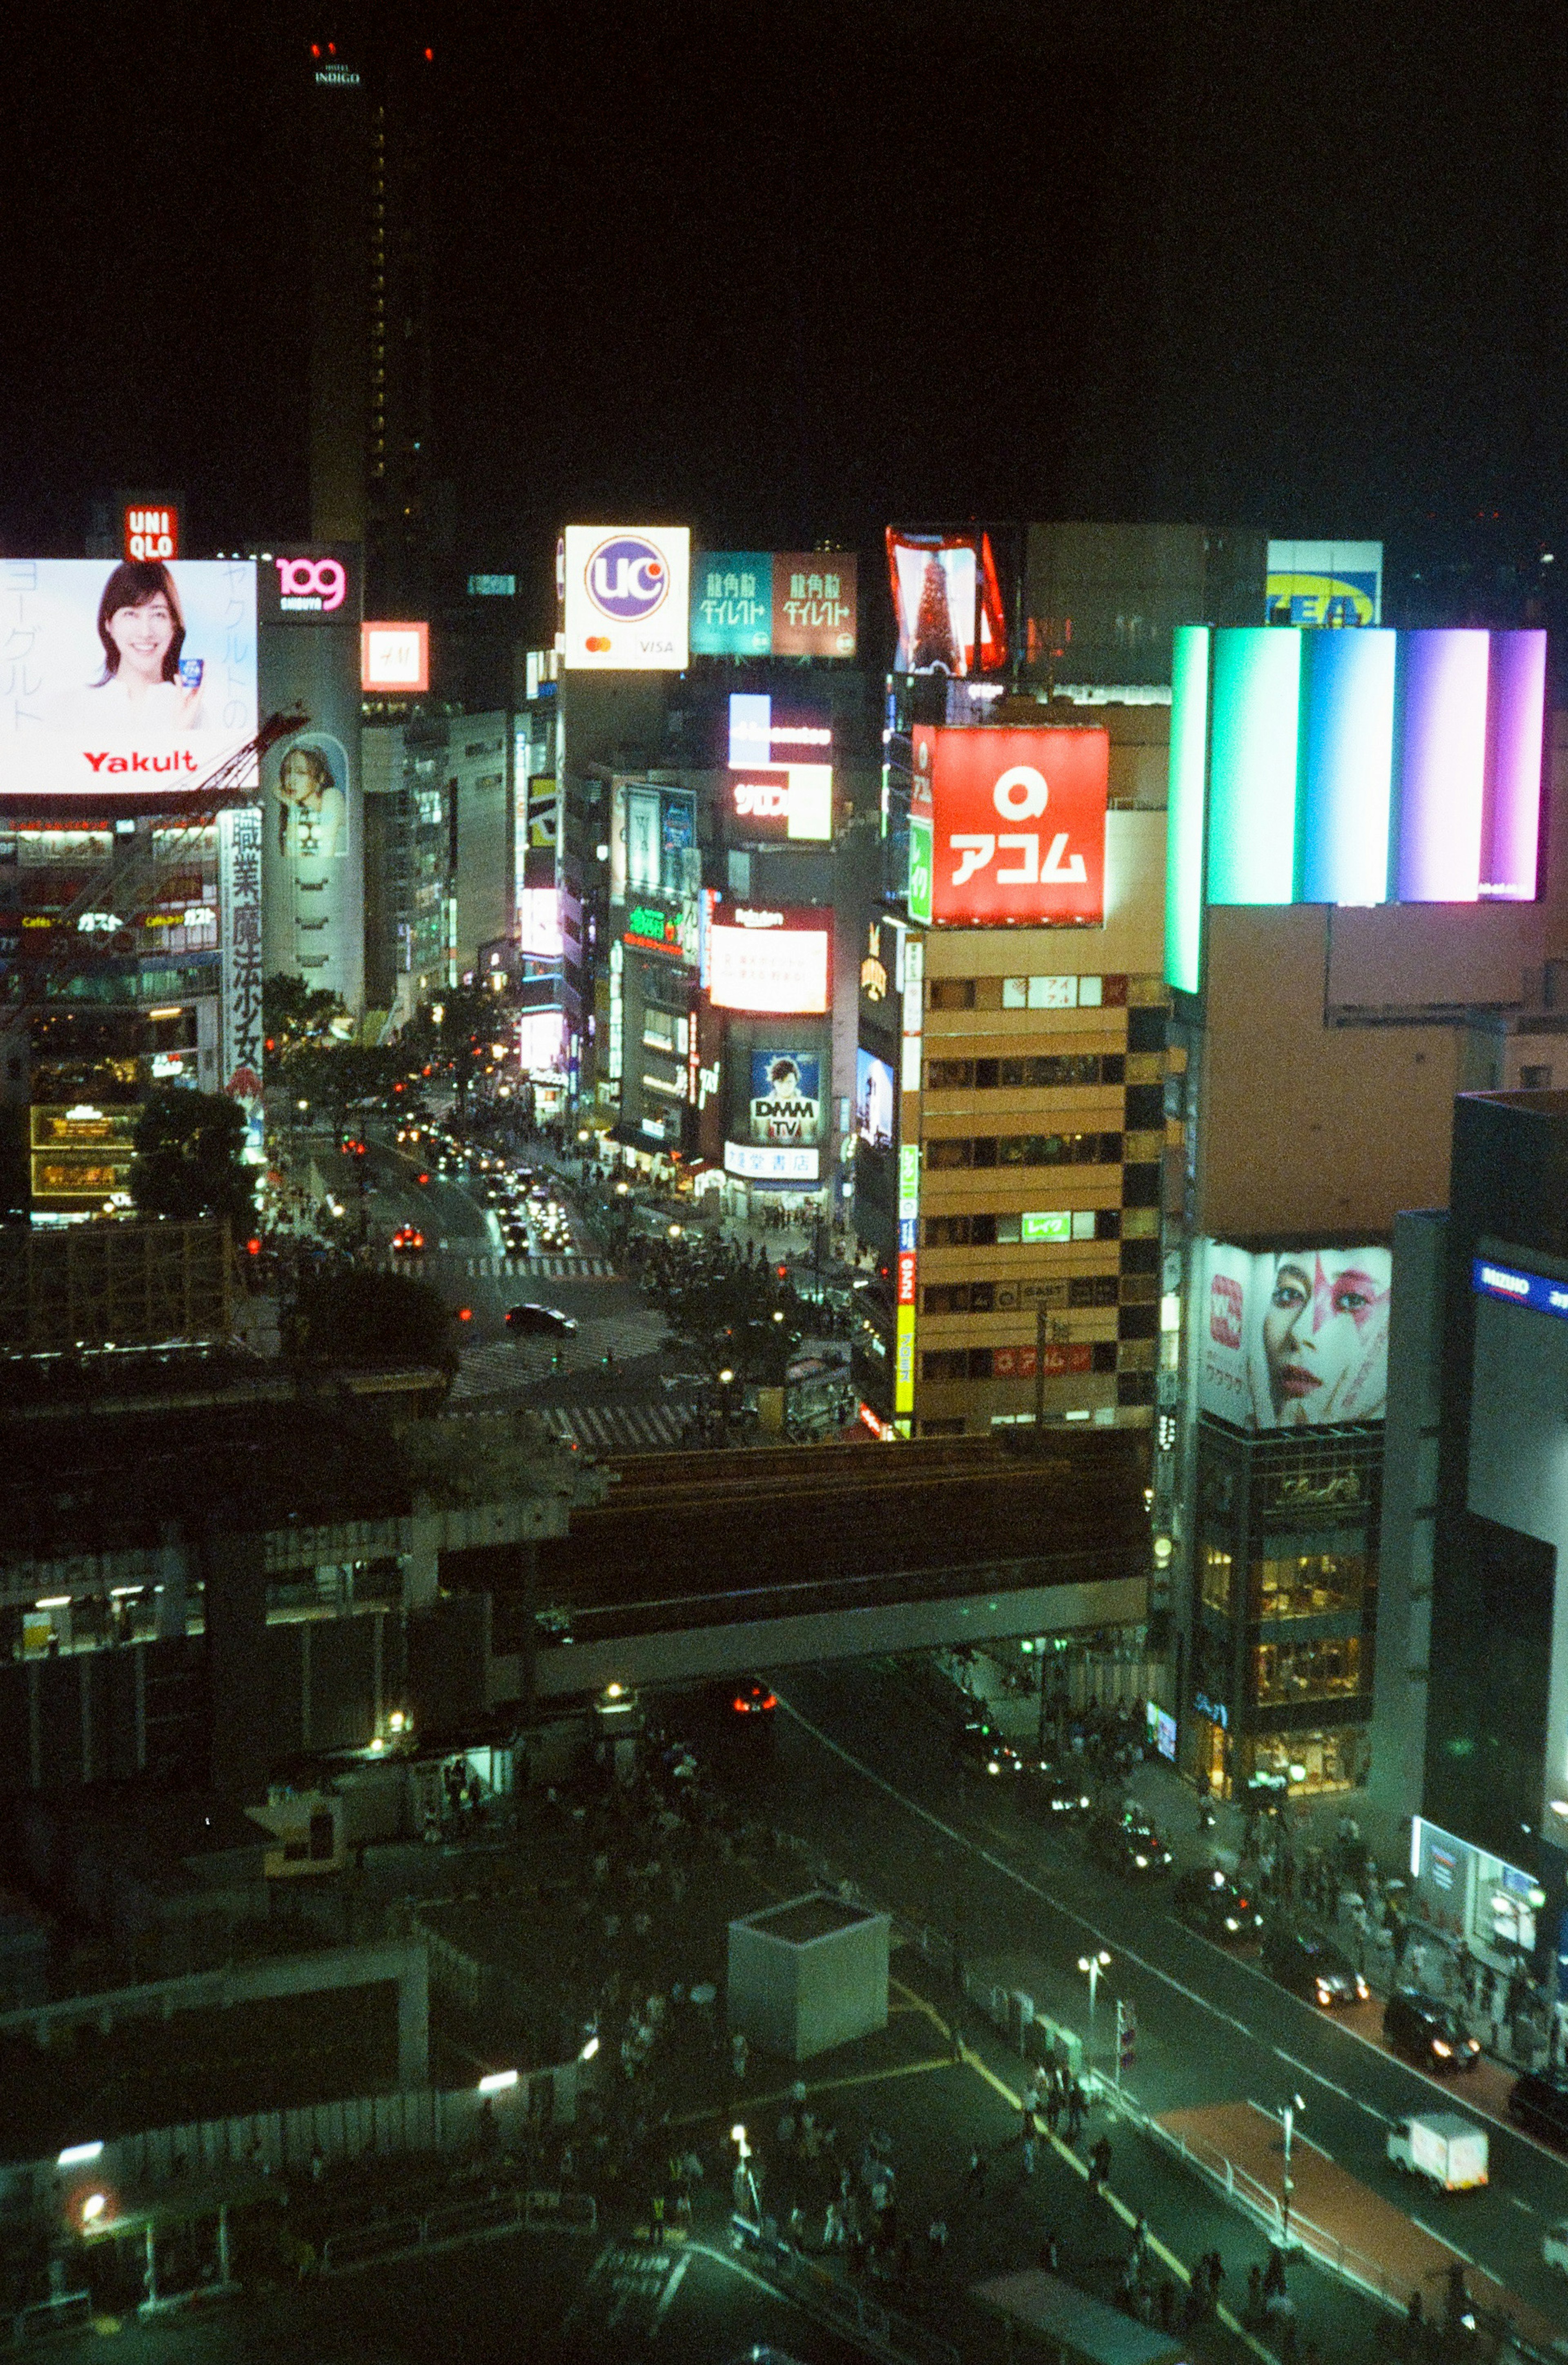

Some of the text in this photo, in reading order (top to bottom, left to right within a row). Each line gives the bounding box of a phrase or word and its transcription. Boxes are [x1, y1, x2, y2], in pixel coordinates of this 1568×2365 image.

[315, 72, 360, 83] INDIGO
[129, 511, 169, 534] UNI
[129, 536, 173, 561] QLO
[276, 558, 346, 612] 109
[706, 573, 755, 599] 龍角散
[790, 573, 840, 600] 龍角散
[699, 600, 766, 627] ダイレクト
[782, 601, 850, 627] ダイレクト
[3, 561, 42, 731] ヨーグルト
[223, 562, 249, 730] ヤクルトの
[640, 641, 673, 653] VISA
[83, 750, 198, 774] Yakult
[950, 833, 1087, 886] アコム
[78, 912, 123, 932] ガスト
[183, 907, 216, 927] ガスト
[755, 1101, 813, 1118] DMM
[773, 1121, 797, 1136] TV
[1482, 1268, 1529, 1295] MIZUHO
[899, 1332, 912, 1383] プロミス
